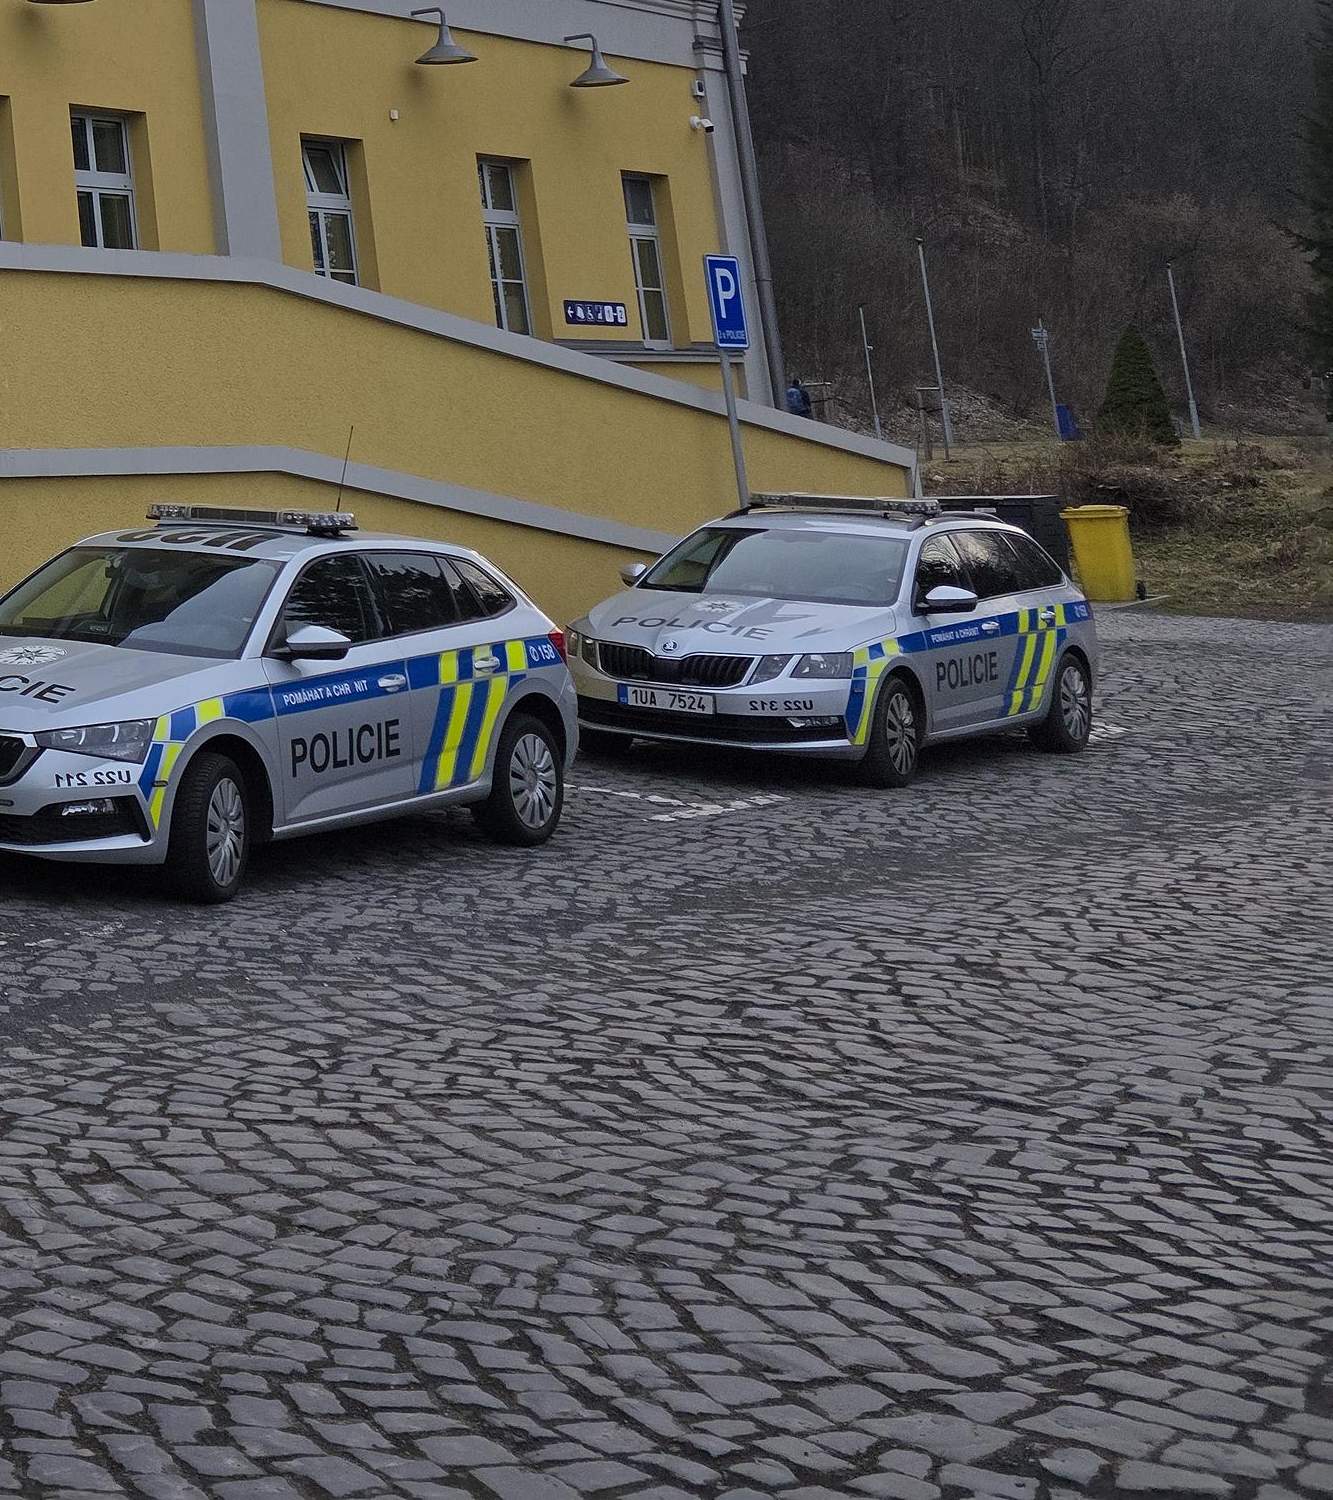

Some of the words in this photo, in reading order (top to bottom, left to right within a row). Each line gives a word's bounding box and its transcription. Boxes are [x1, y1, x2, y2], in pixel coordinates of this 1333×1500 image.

[715, 267, 735, 319] P
[611, 616, 774, 641] POLICIE
[538, 643, 556, 660] 158
[936, 651, 998, 693] POLICIE
[282, 687, 324, 706] POMÁHAT
[326, 687, 333, 698] A
[631, 689, 657, 706] 1UA
[668, 693, 706, 712] 7524
[290, 718, 401, 779] POLICIE
